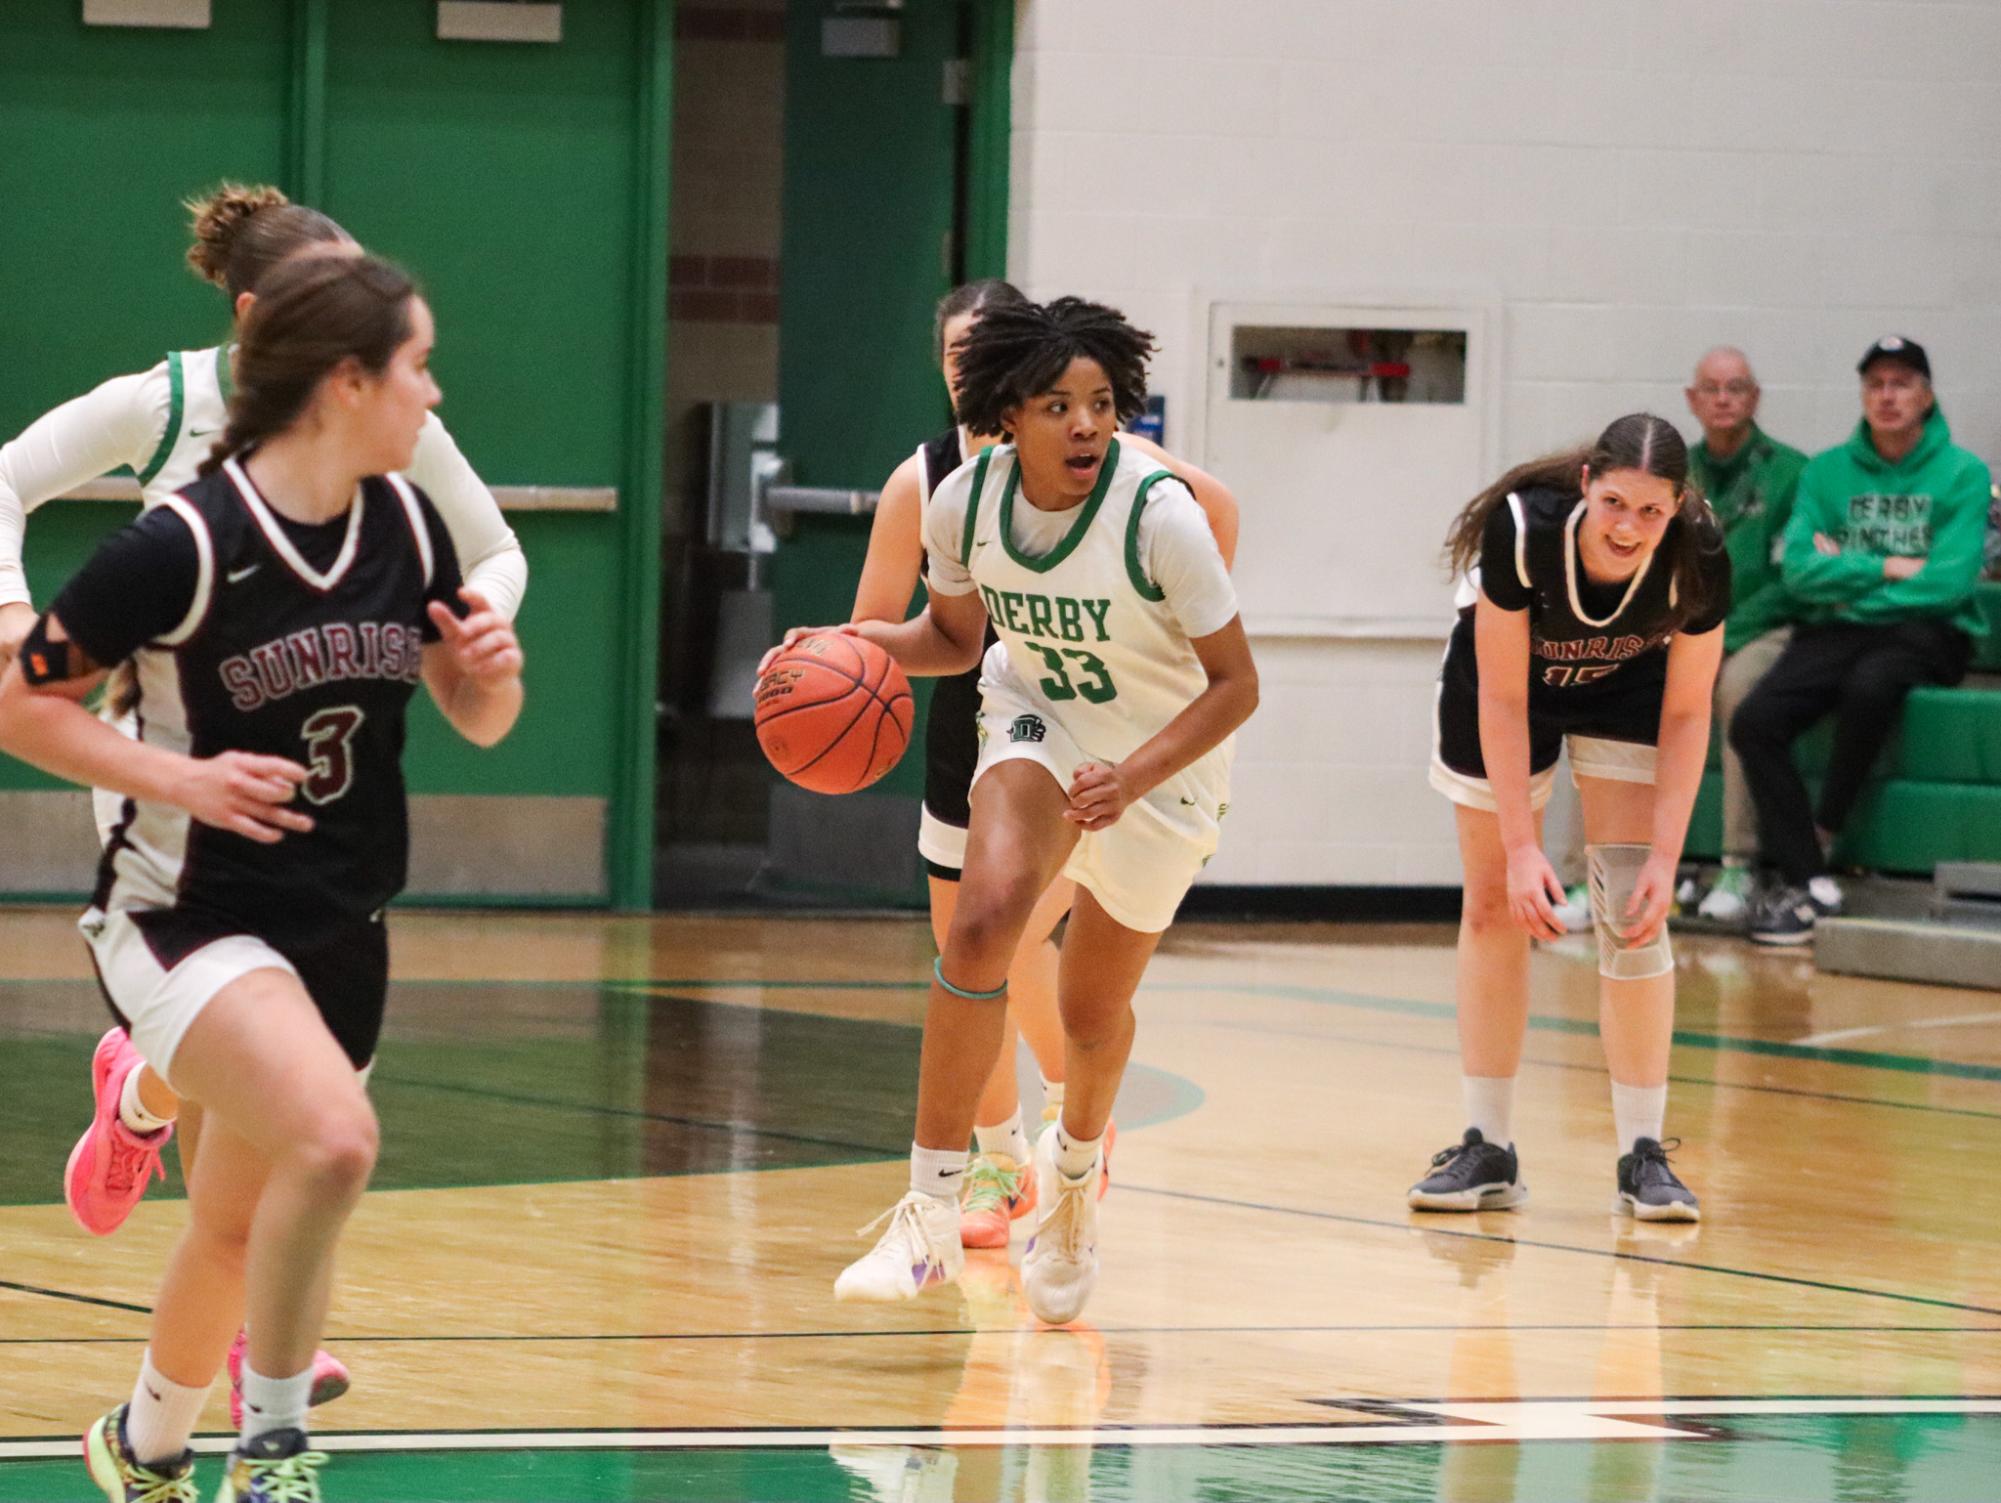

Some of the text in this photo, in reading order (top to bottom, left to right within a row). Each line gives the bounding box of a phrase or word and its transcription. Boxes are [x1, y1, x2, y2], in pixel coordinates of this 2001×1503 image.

[980, 583, 1111, 642] DERBY
[1024, 641, 1118, 704] 33
[301, 705, 365, 805] 3
